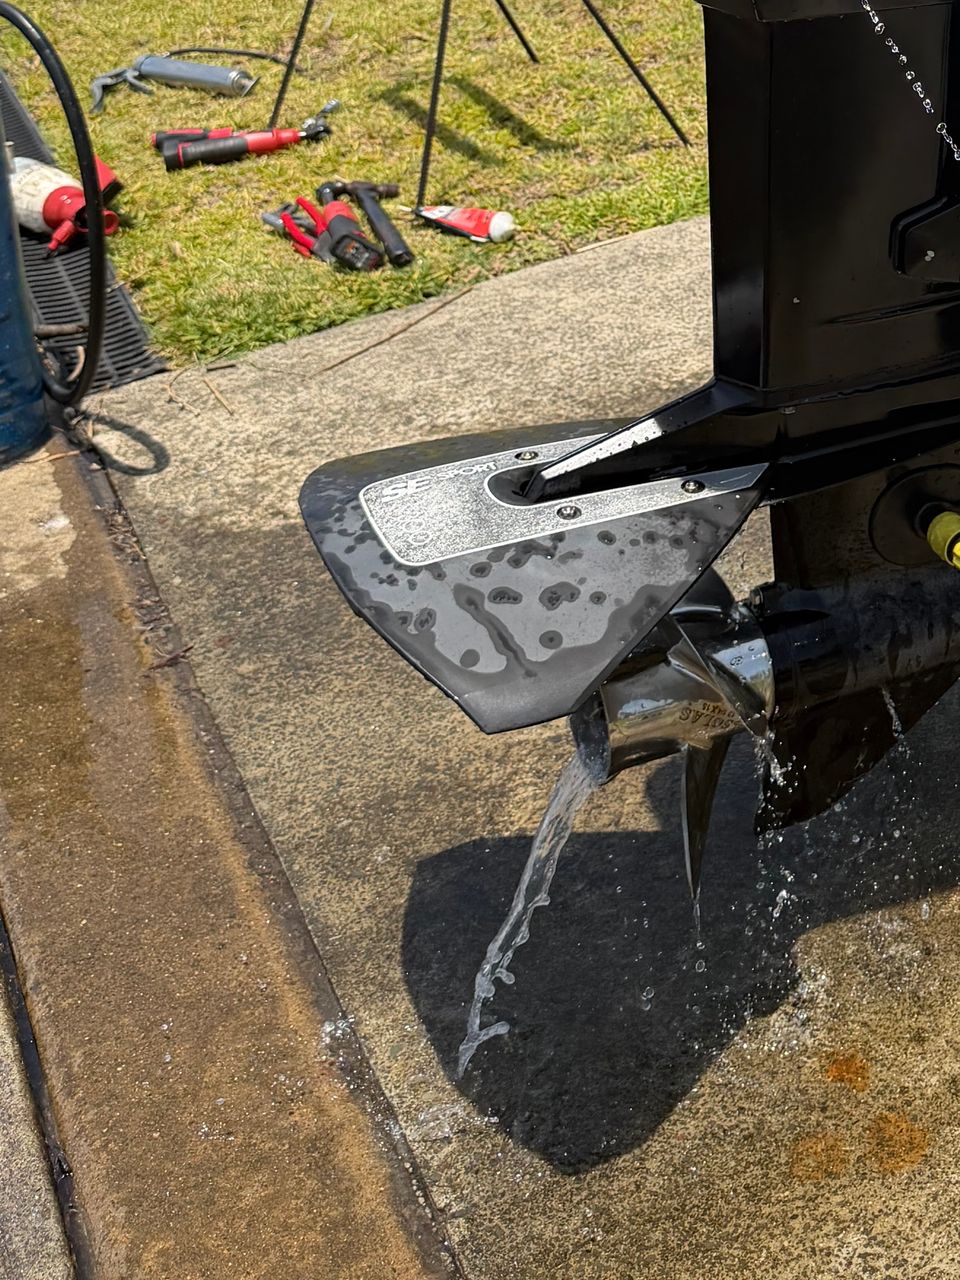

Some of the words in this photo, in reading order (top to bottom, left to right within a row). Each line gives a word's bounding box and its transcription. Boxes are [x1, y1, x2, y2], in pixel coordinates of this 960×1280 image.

[381, 476, 435, 502] SE
[435, 461, 498, 480] SPORT
[679, 707, 735, 729] SOLAS
